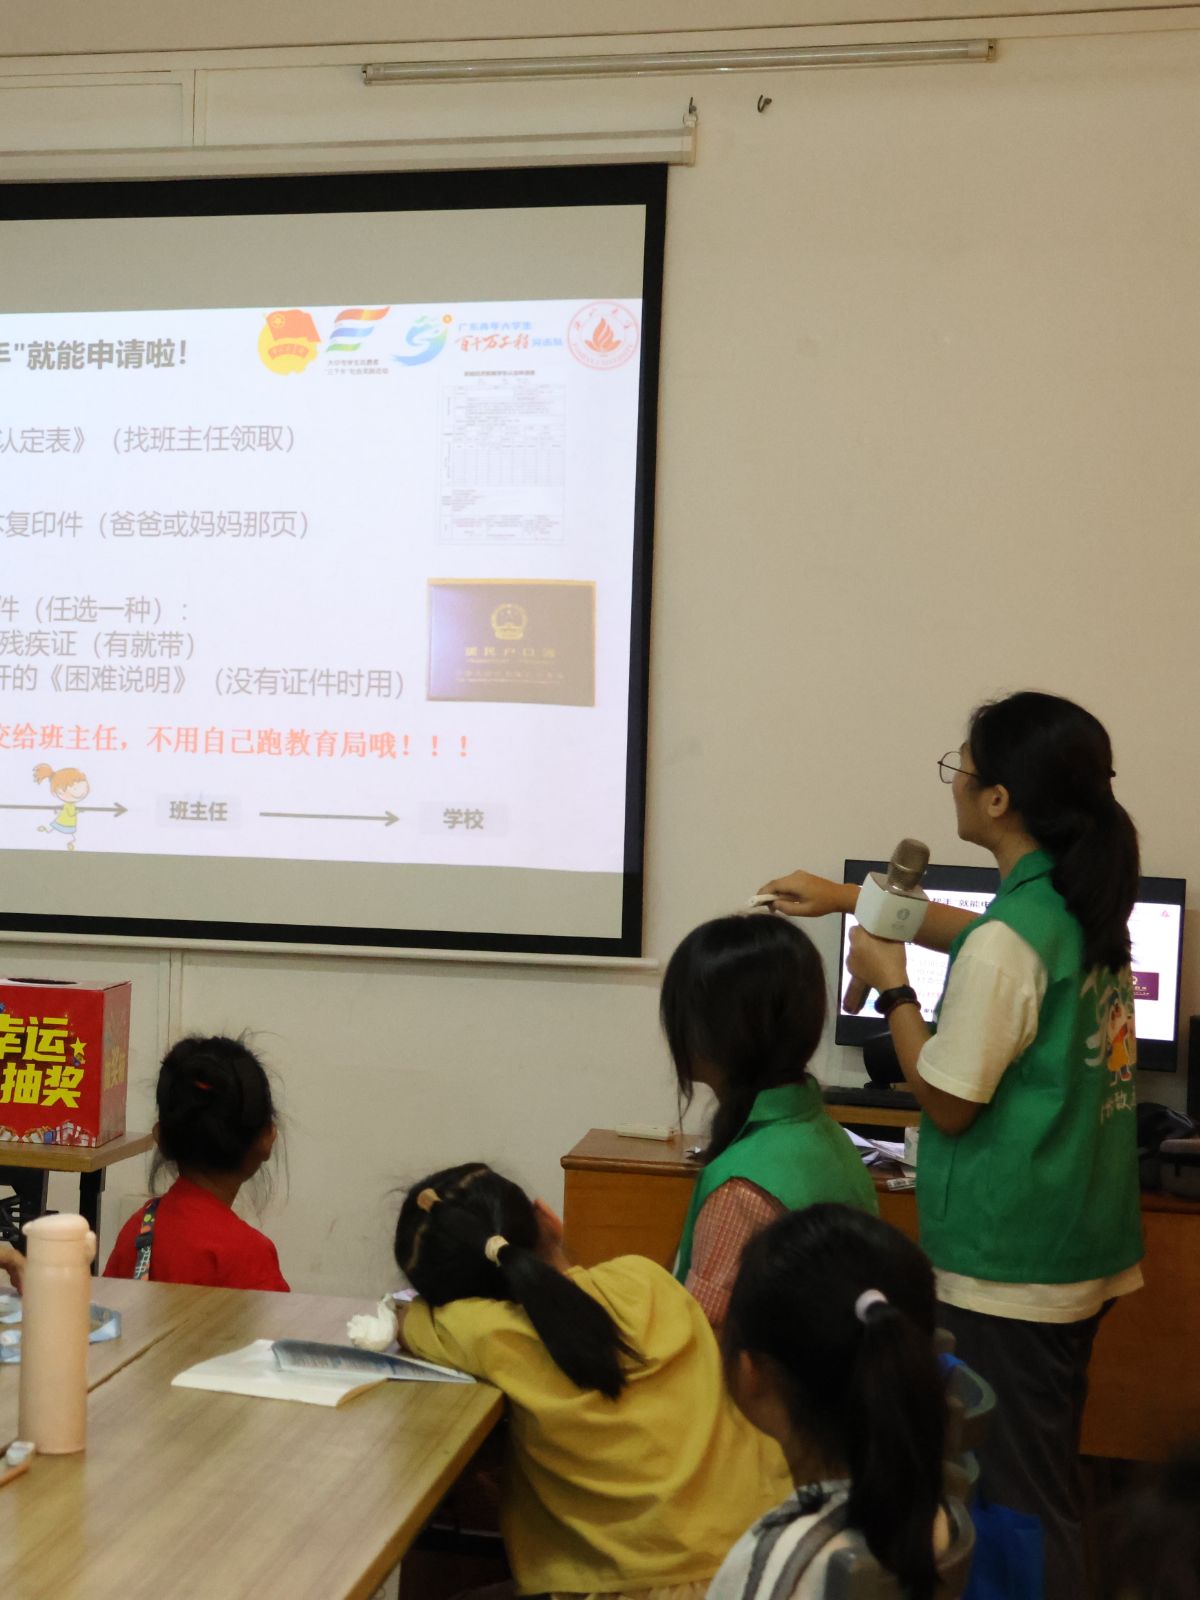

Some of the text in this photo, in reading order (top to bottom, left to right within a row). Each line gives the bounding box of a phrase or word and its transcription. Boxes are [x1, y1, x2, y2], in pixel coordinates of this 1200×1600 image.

[169, 801, 228, 822] 班主任
[442, 808, 486, 831] 学校
